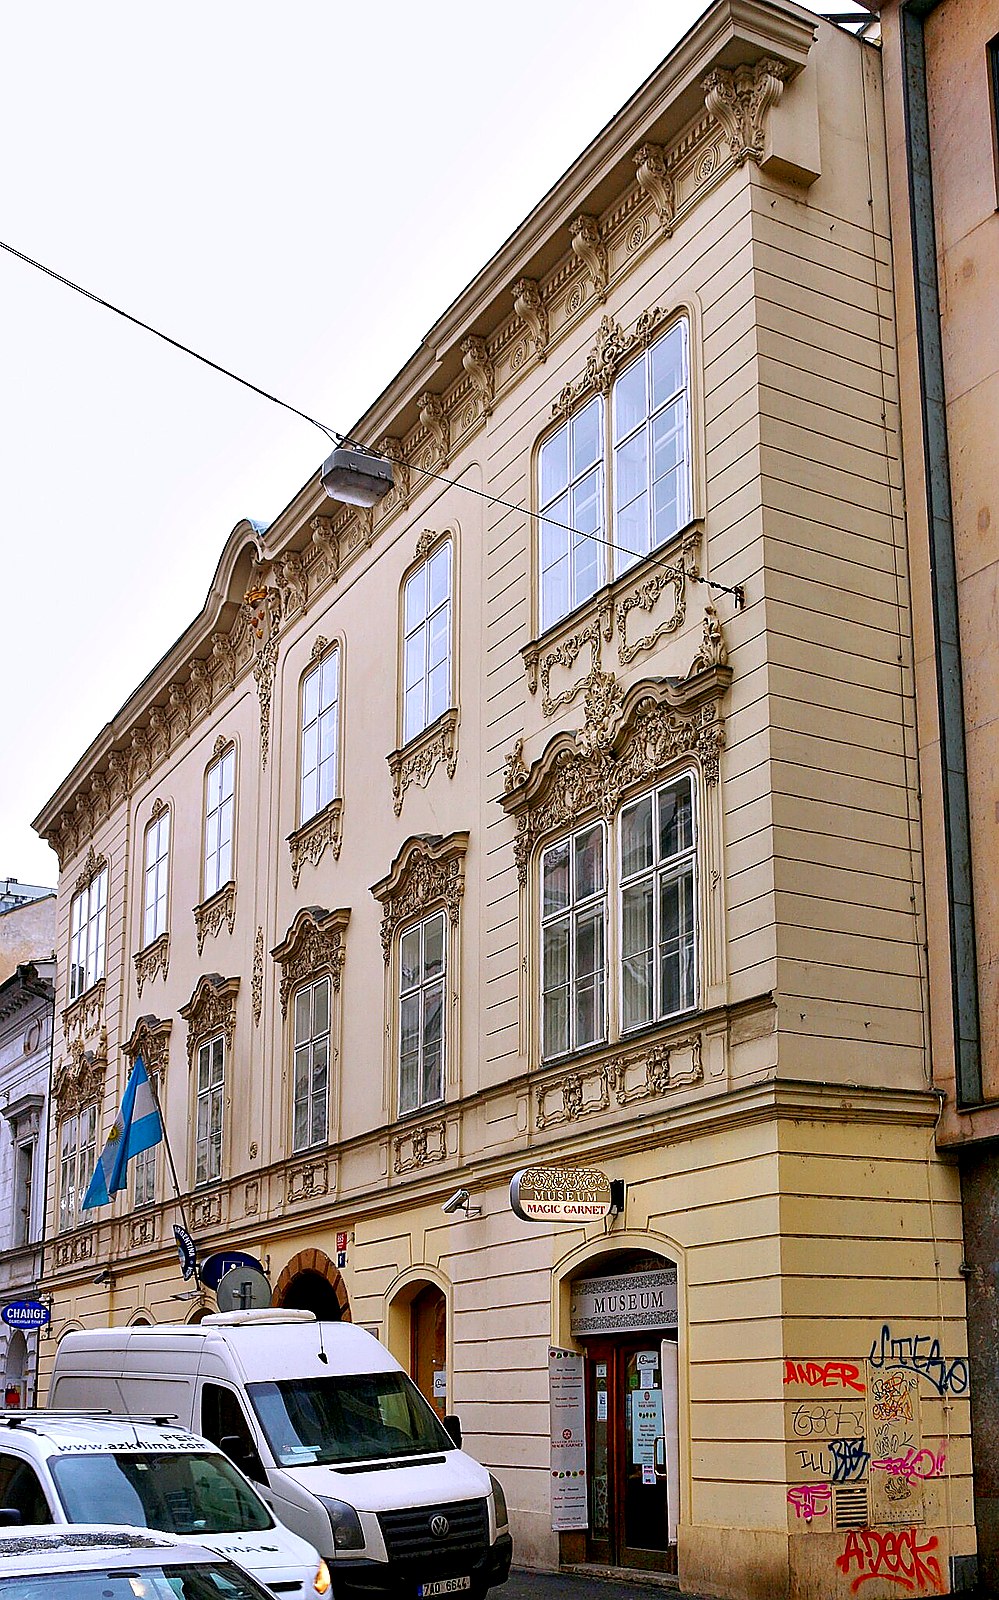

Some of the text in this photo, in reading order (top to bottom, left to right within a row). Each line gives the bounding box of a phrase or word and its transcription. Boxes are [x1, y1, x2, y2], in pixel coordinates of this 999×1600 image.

[534, 1191, 597, 1202] MUSEUM
[527, 1204, 606, 1215] MAGIC GARNET
[593, 1291, 664, 1314] MUSEUM
[7, 1308, 47, 1319] CHANGE
[783, 1361, 866, 1392] ANDER
